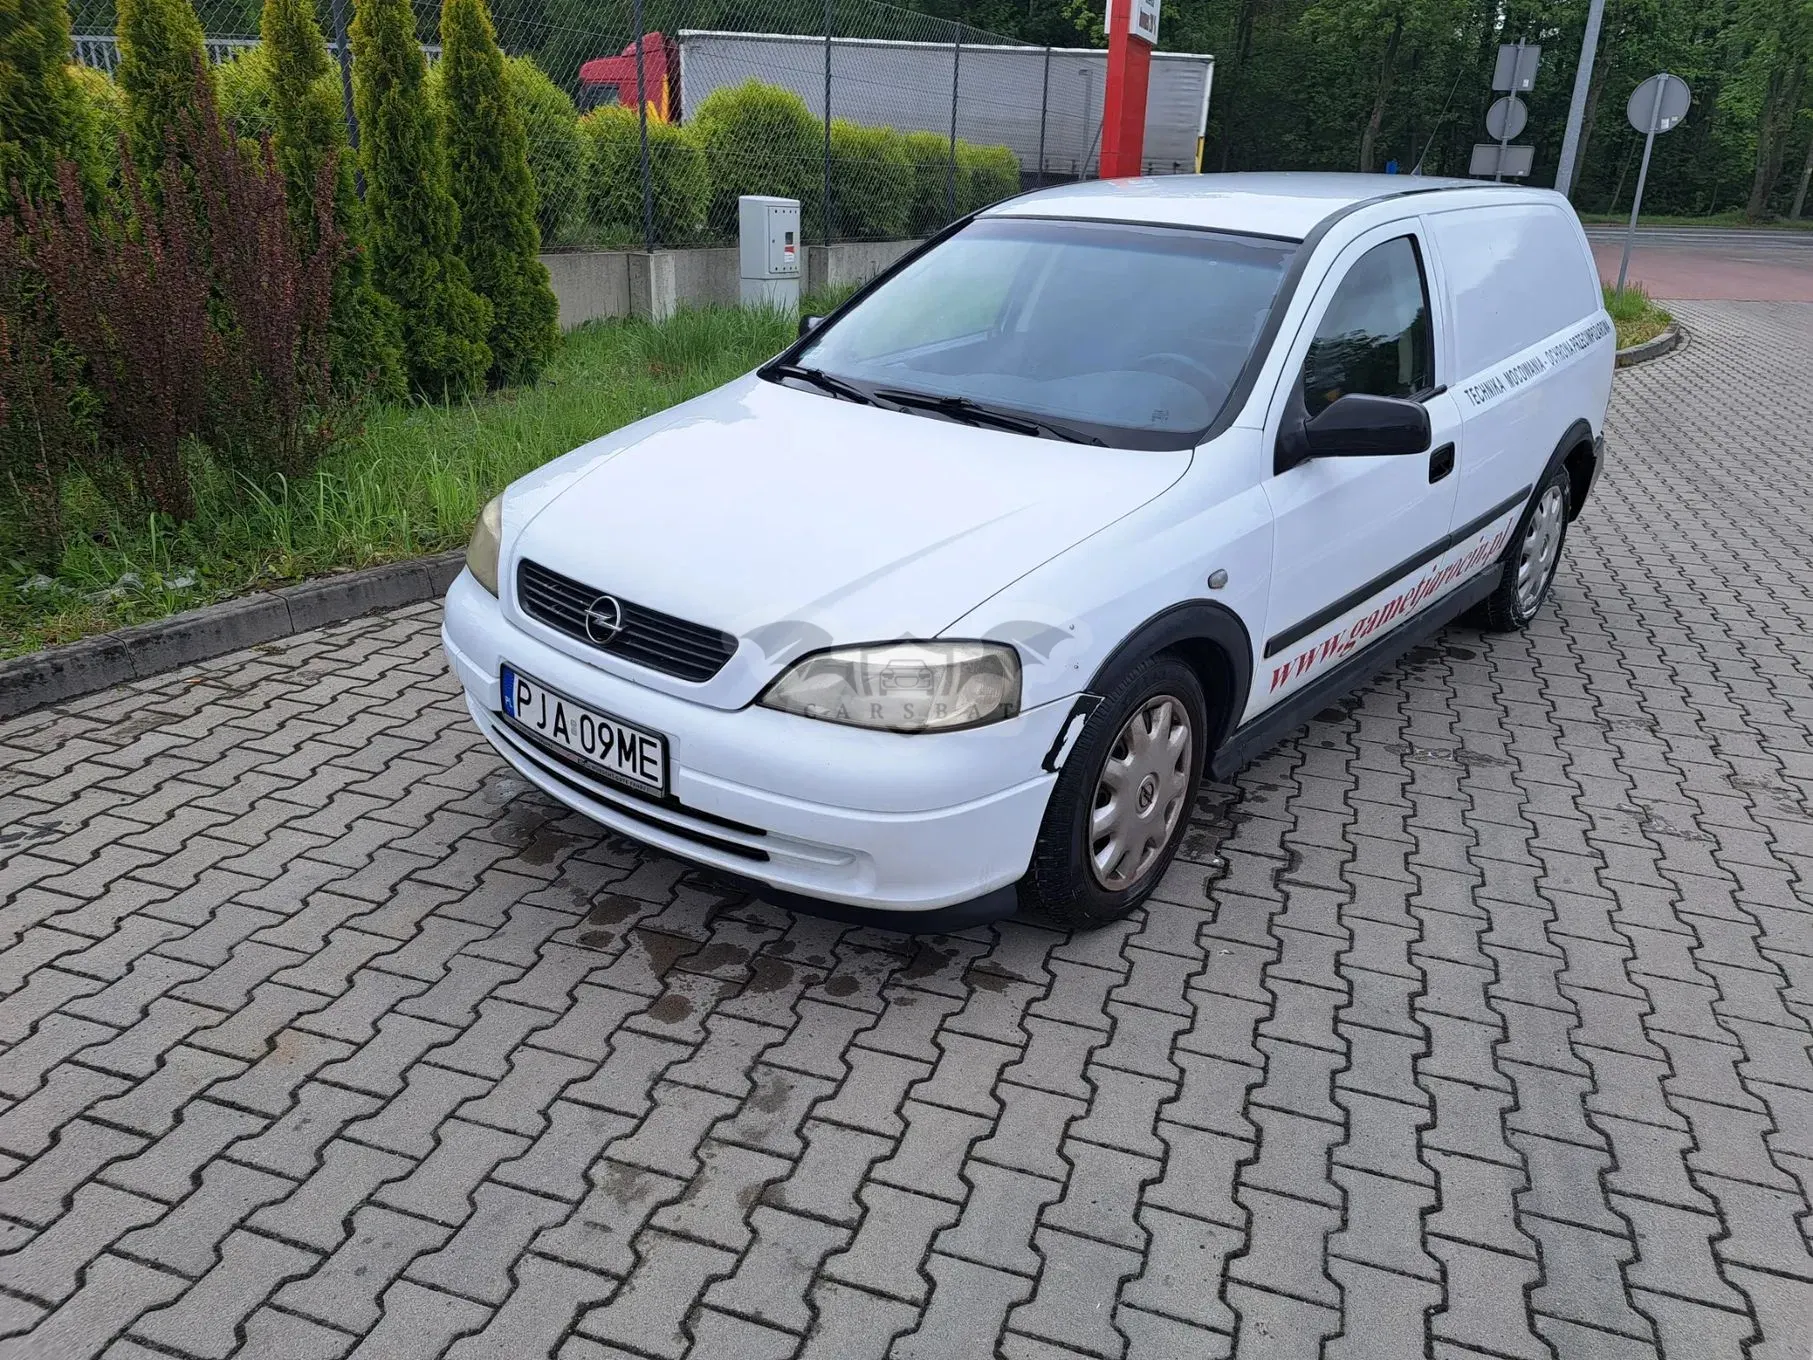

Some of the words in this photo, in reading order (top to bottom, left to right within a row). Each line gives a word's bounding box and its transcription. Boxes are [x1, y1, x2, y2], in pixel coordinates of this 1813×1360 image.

[1464, 376, 1507, 407] TECHNIKA
[1503, 356, 1547, 389] MOCOWANIA
[1545, 339, 1575, 368] OCHRONA
[1269, 517, 1514, 695] www.gametjarocin.pl
[517, 678, 571, 745] PJA
[579, 713, 659, 783] 09ME
